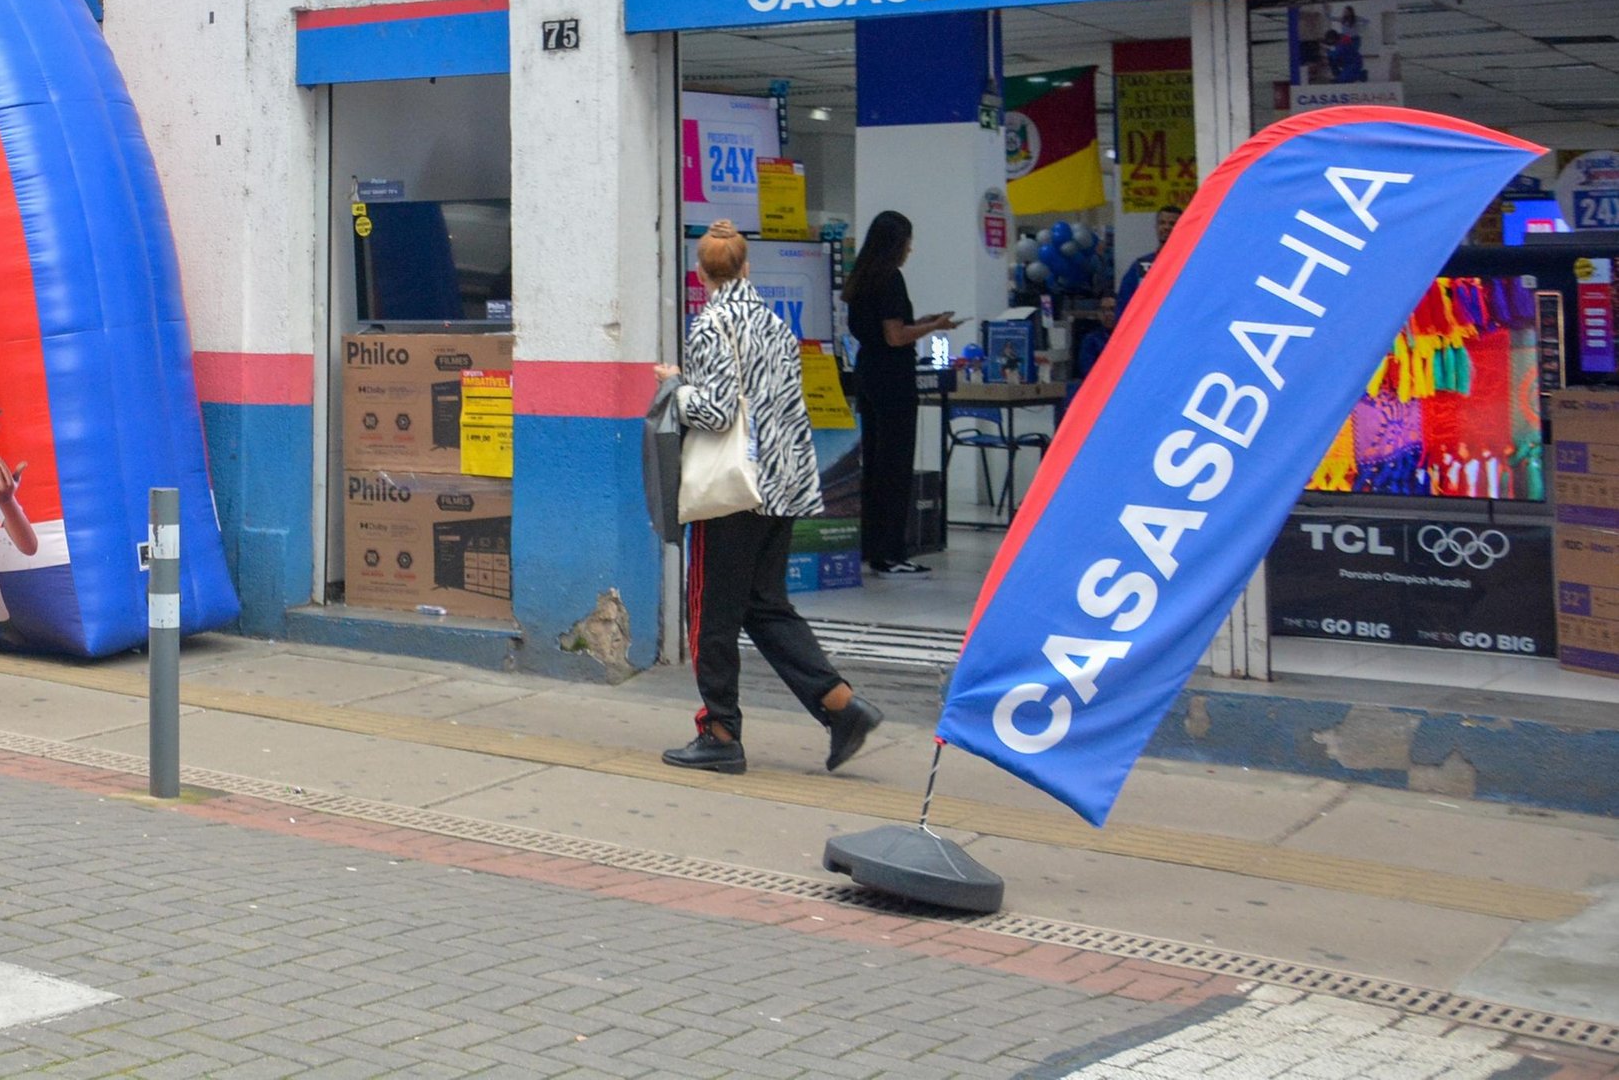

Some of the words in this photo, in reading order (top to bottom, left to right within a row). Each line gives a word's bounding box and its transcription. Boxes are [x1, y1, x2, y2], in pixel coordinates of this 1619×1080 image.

[545, 21, 578, 49] 75
[709, 145, 757, 184] 24X
[346, 341, 410, 365] Philco
[462, 375, 509, 387] IMBATÍVEL
[992, 164, 1415, 756] CASASBAHIA
[348, 477, 412, 503] Philco
[1300, 523, 1395, 556] TCL
[1338, 568, 1382, 581] Parceiro
[1428, 575, 1472, 589] Mundial
[1321, 617, 1351, 635] GO
[1355, 620, 1392, 639] BIG
[1458, 630, 1492, 648] GO
[1496, 634, 1536, 653] BIG
